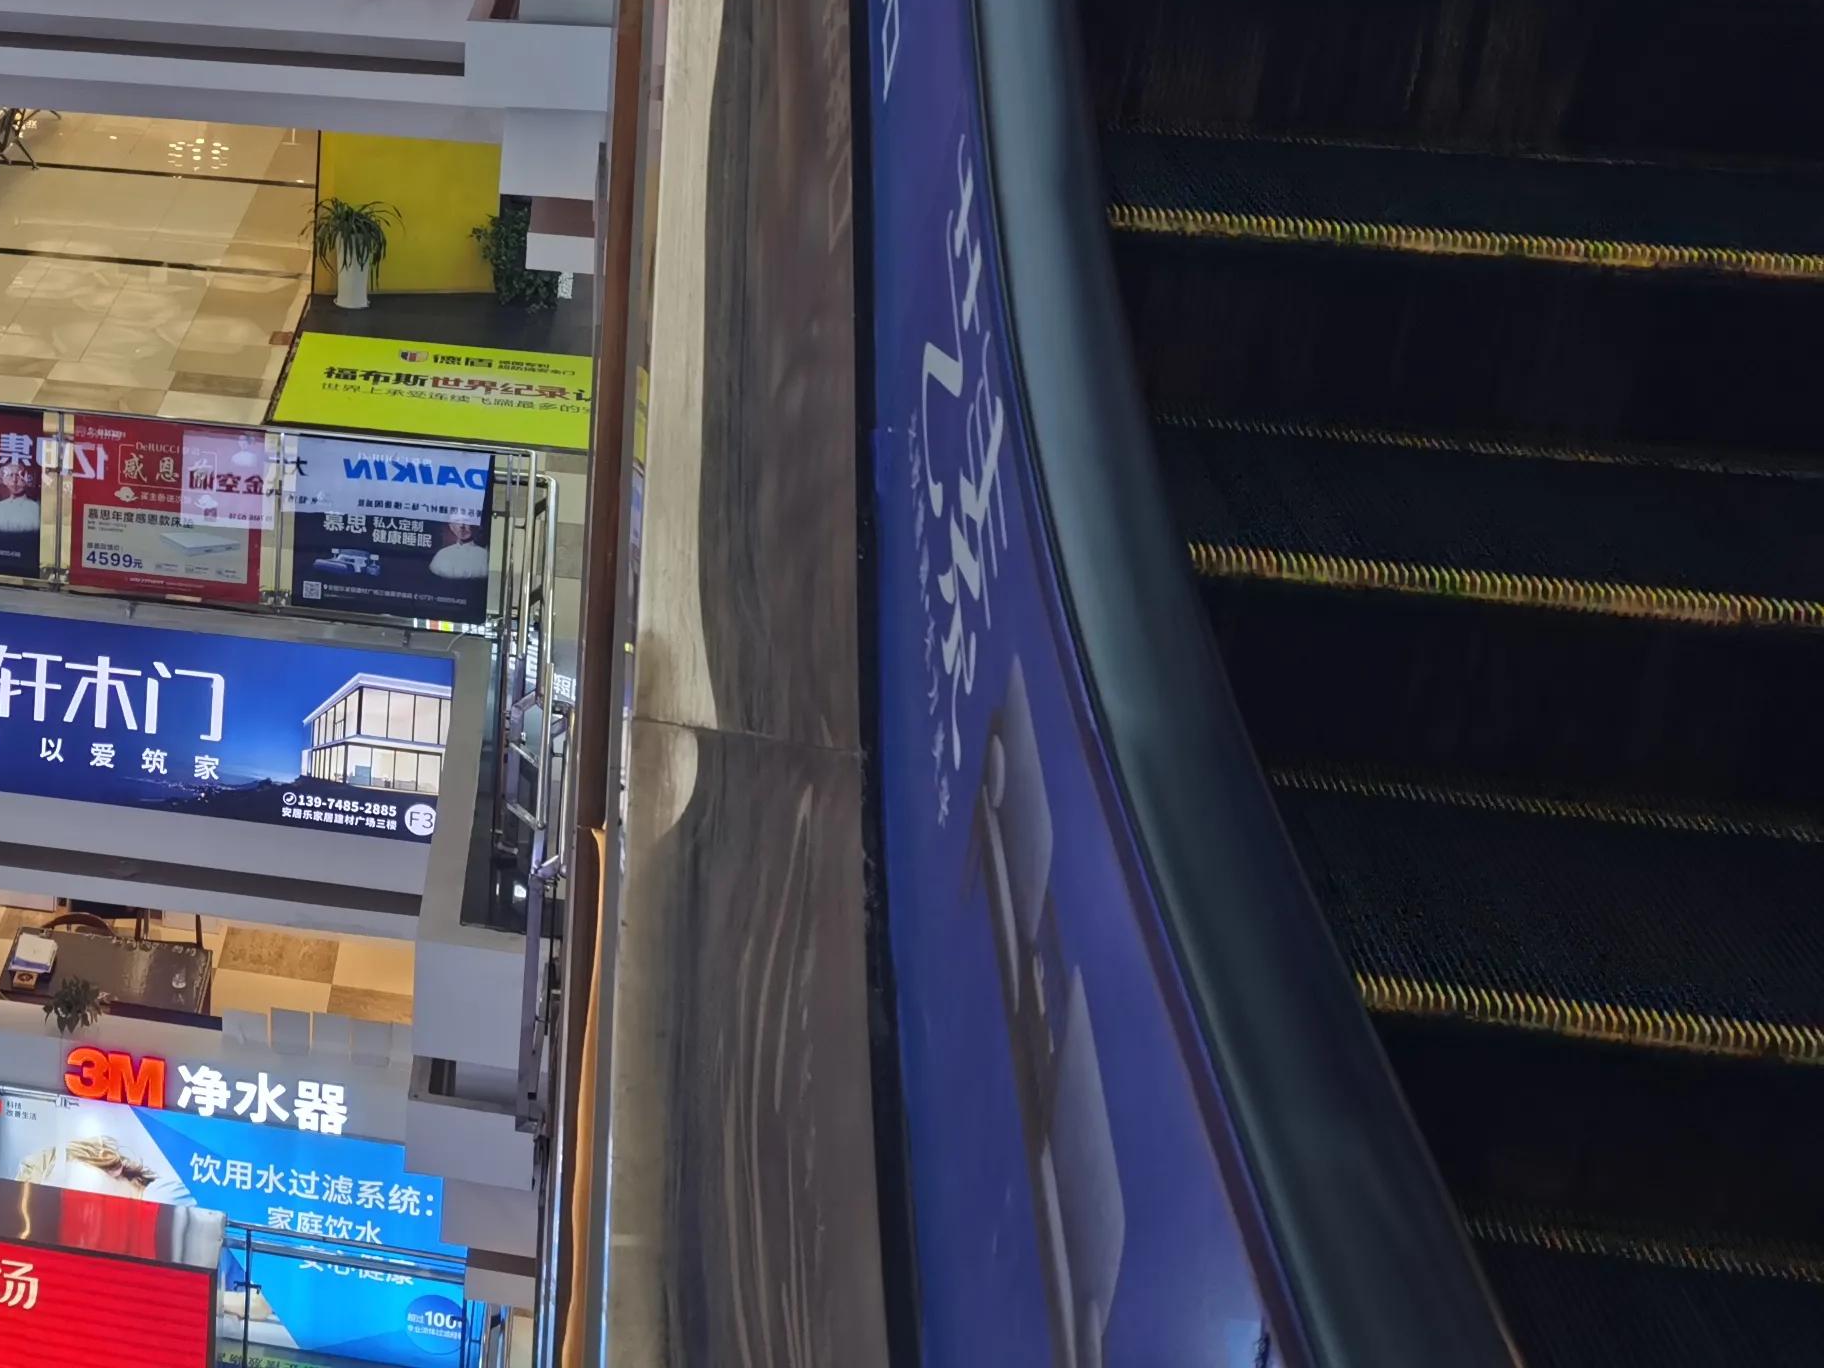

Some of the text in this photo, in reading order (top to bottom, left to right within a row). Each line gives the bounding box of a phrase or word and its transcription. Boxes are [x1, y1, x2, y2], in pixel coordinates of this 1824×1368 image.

[324, 512, 367, 533] 慕思
[86, 550, 143, 569] 4599元
[40, 737, 220, 779] 以爱筑家
[298, 794, 397, 816] 139-7485-2885
[65, 1047, 349, 1135] 3M 净水器
[190, 1153, 435, 1218] 饮用水过滤系统：
[267, 1207, 382, 1245] 家庭饮水
